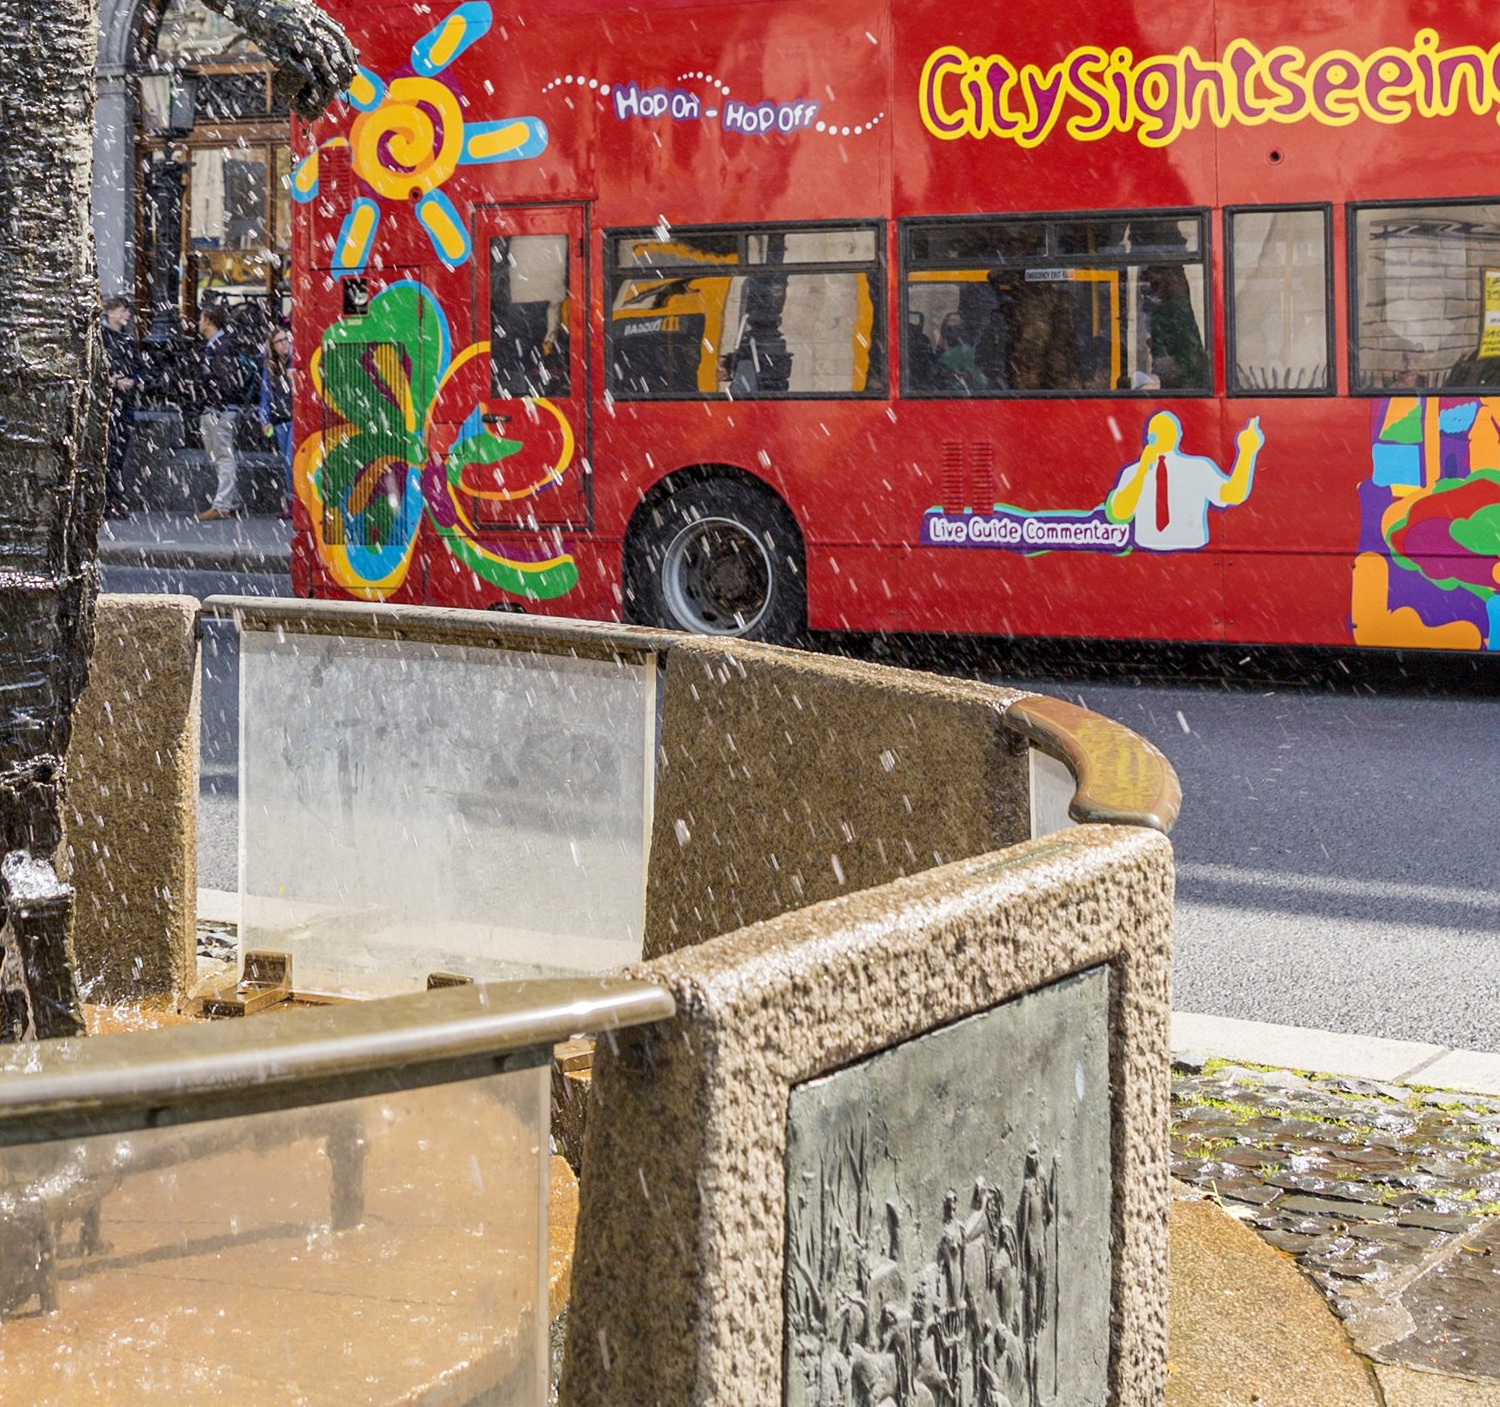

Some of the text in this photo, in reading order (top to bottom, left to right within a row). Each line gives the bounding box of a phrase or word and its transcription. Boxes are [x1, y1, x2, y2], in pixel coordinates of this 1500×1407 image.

[671, 93, 699, 120] On
[779, 104, 817, 131] Off
[930, 514, 1131, 547] Live Guide Commentary
